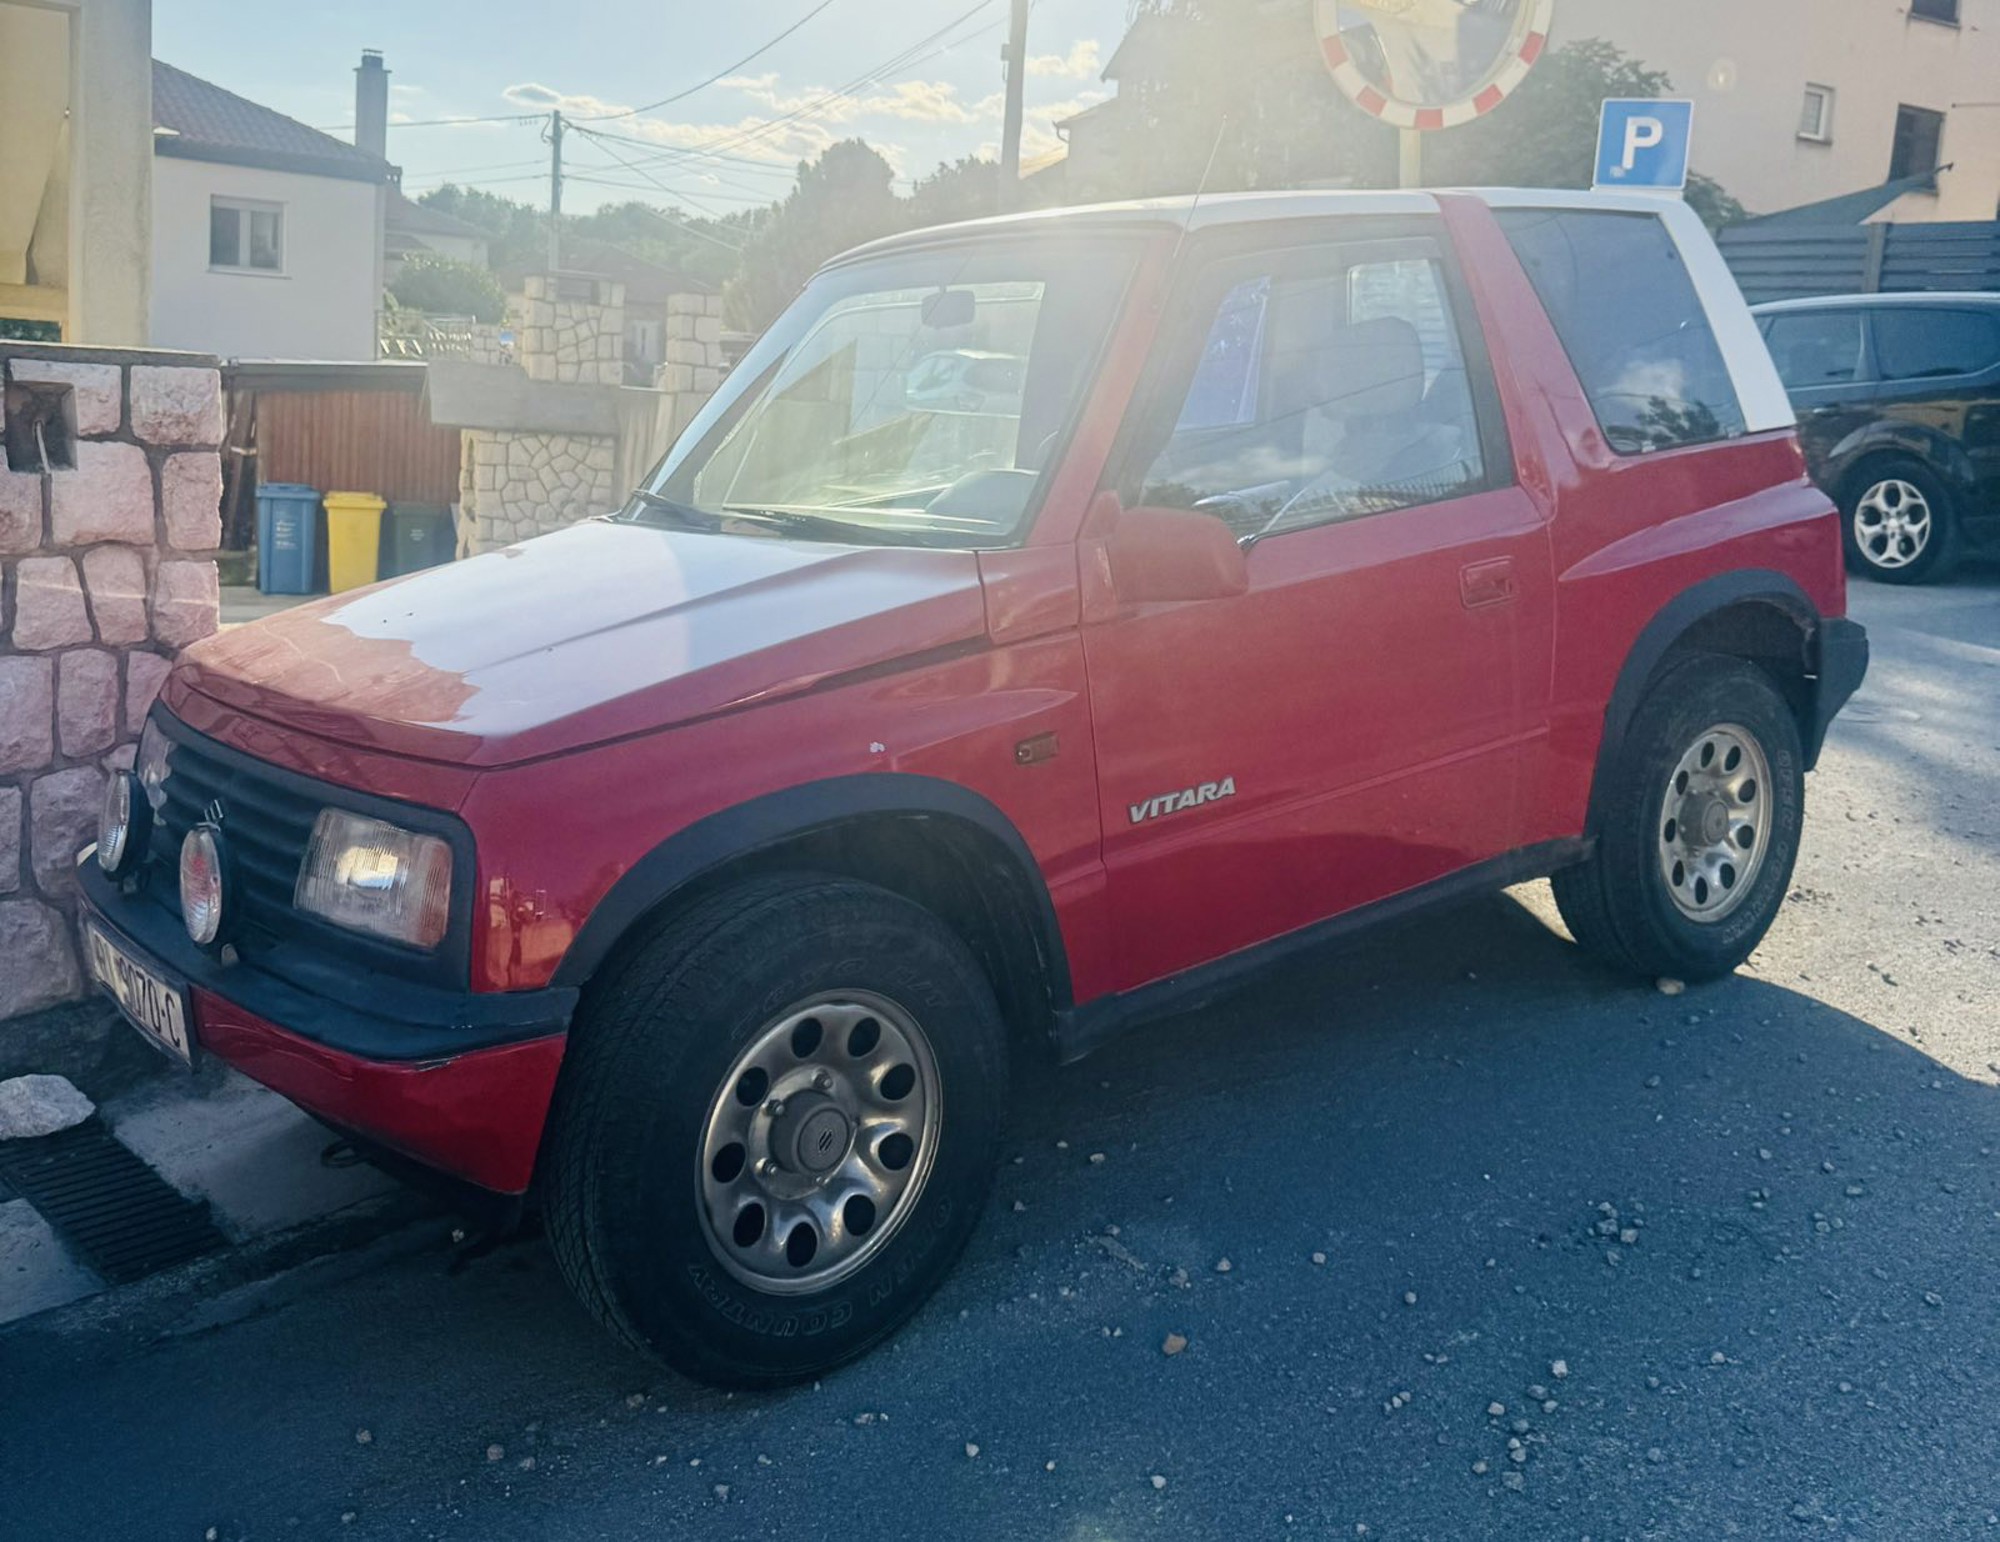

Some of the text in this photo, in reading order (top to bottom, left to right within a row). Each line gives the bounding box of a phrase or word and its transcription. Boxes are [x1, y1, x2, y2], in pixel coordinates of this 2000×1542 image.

[1621, 116, 1663, 170] P
[1130, 776, 1236, 823] VITARA
[687, 1263, 853, 1337] COUNTRY
